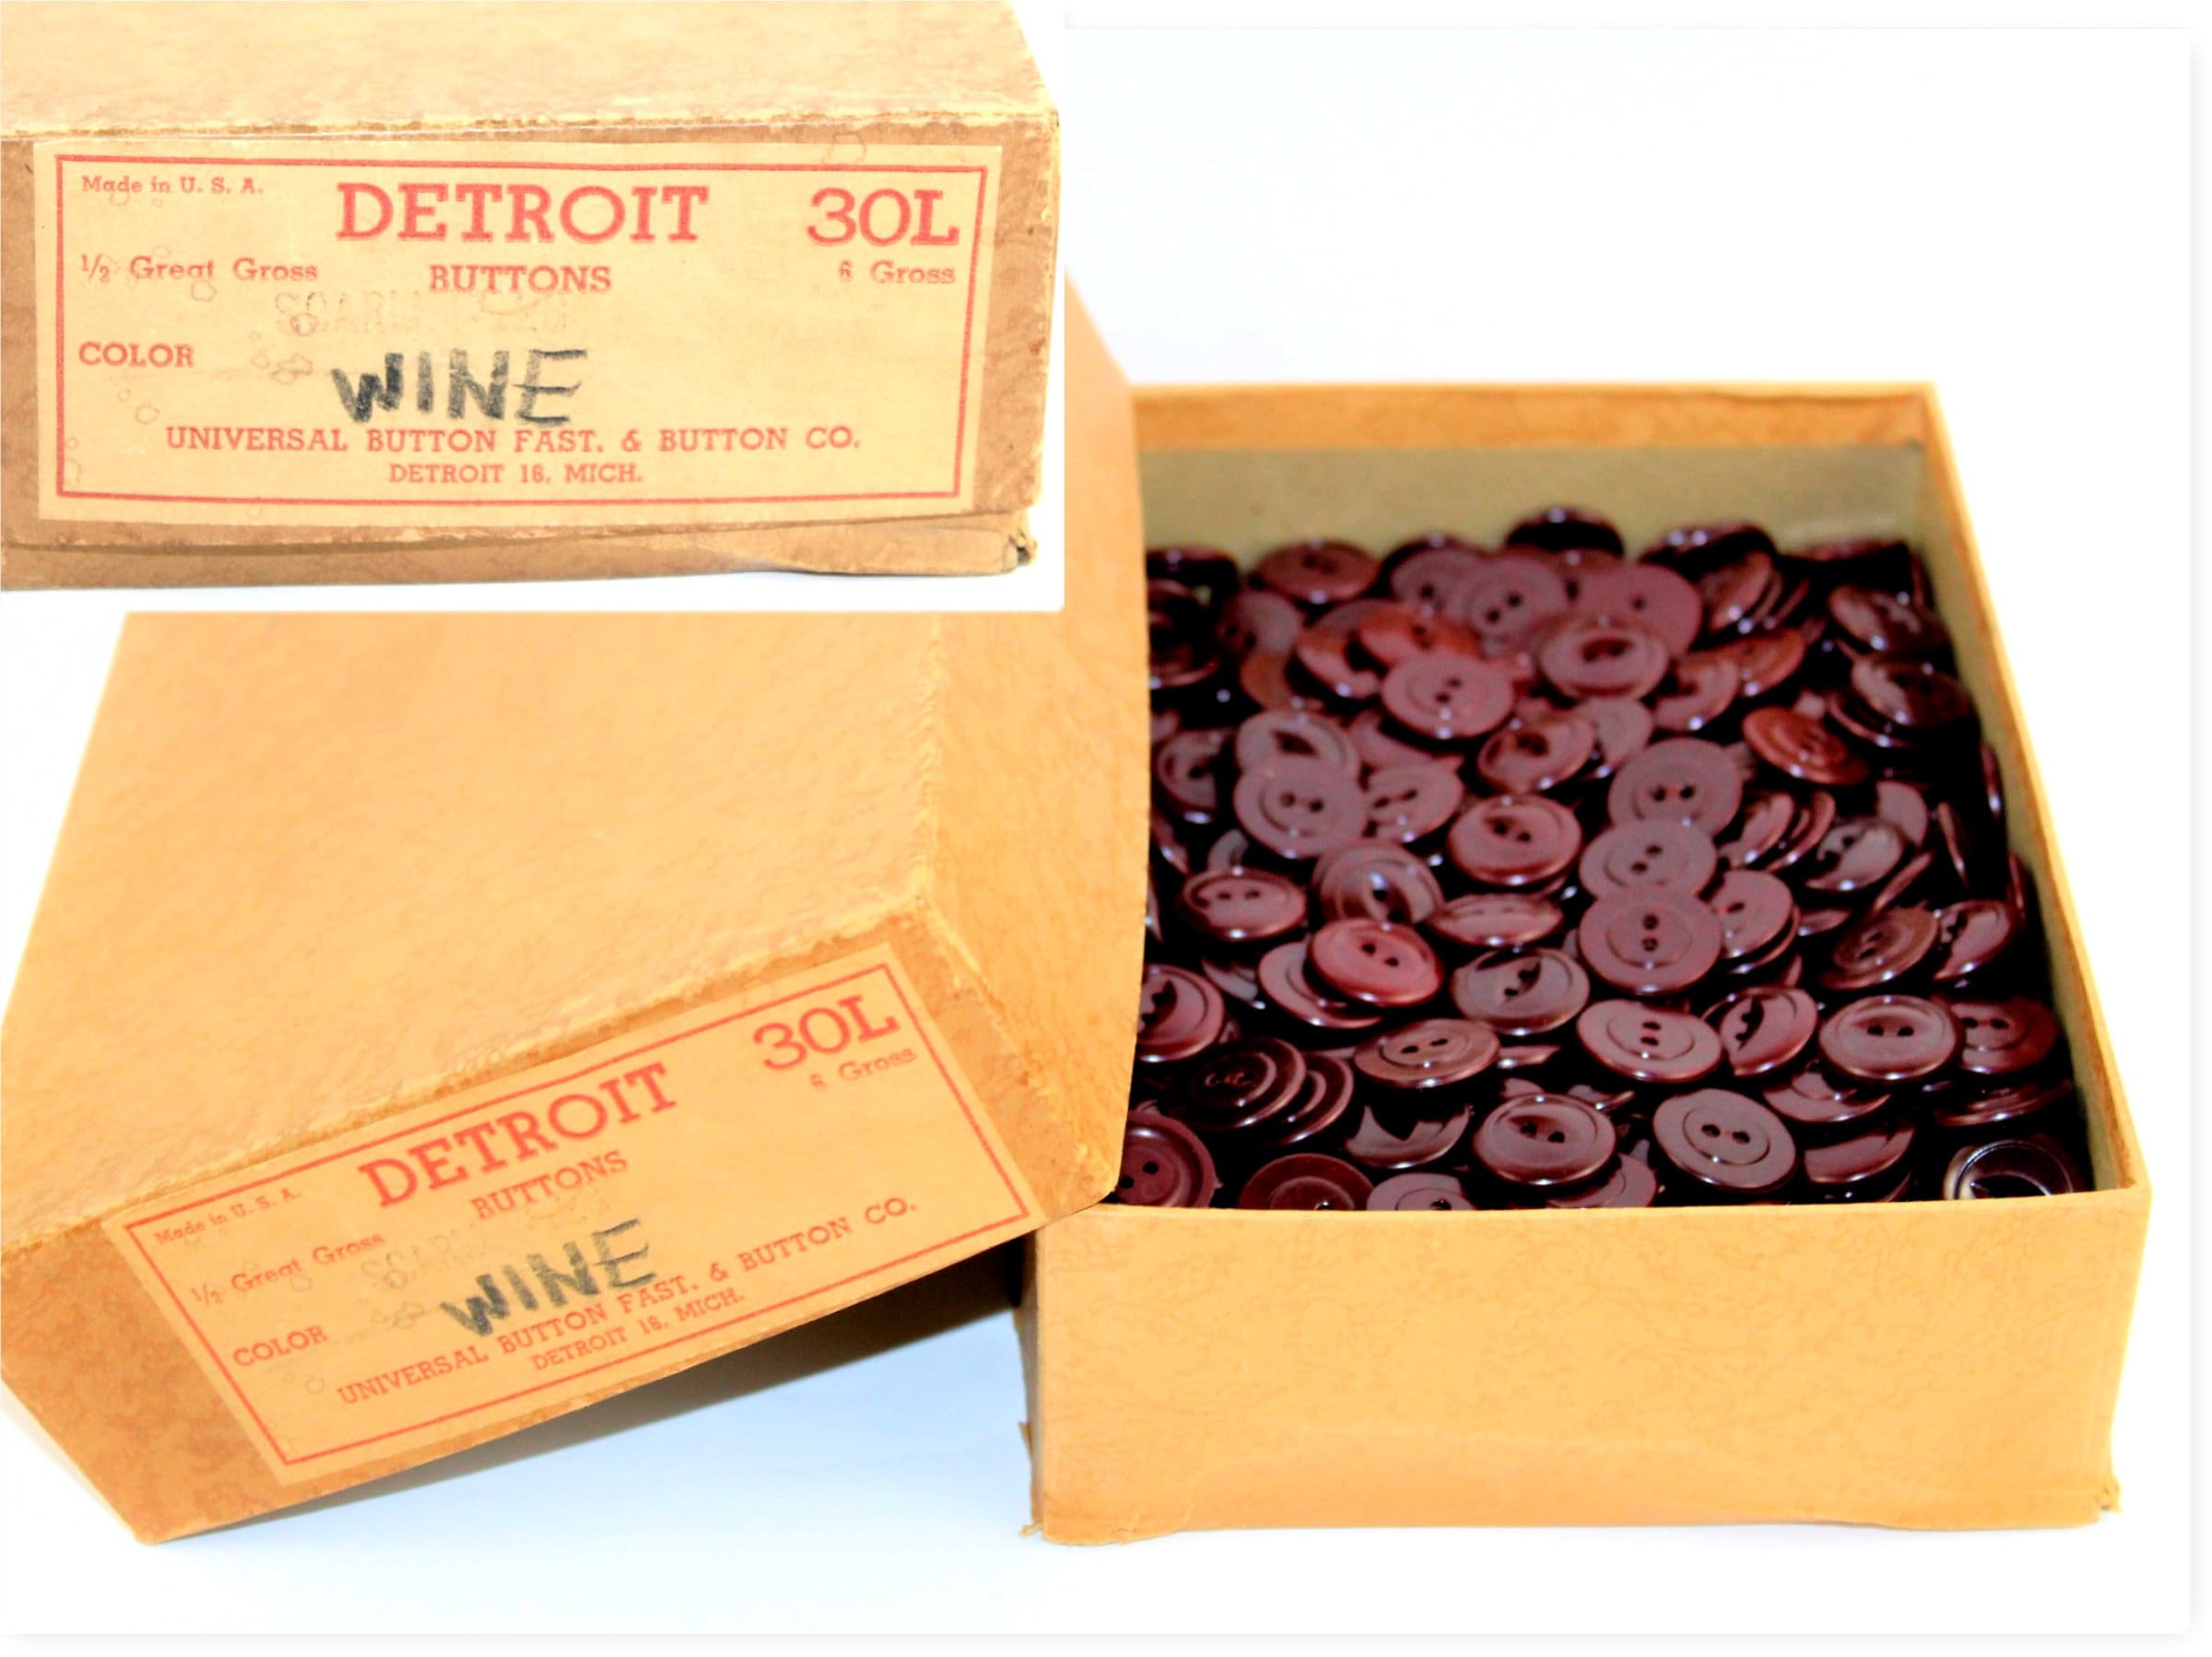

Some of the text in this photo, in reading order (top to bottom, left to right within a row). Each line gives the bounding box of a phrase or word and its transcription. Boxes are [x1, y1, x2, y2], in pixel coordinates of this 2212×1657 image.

[81, 175, 264, 194] Made in U. S. A.
[336, 182, 709, 244] DETROIT
[806, 187, 959, 247] 30L
[129, 256, 214, 280] Great
[233, 257, 318, 282] Gross
[429, 264, 612, 294] BUTTONS
[839, 261, 957, 284] 6 Gross
[79, 342, 194, 368] COLOR
[332, 348, 587, 425] WINE
[166, 426, 861, 452] UNIVERSAL BUTTON FAST. & BUTTON CO.
[389, 464, 505, 484] DETROIT
[565, 464, 642, 484] MICH.
[751, 994, 900, 1071] 30L
[838, 1048, 917, 1081] Gross
[358, 1063, 677, 1207] DETROIT
[471, 1149, 628, 1220] BUTTONS
[154, 1219, 206, 1245] Made
[209, 1211, 230, 1230] in
[230, 1259, 302, 1292] Great
[312, 1233, 385, 1266] Gross
[441, 1217, 657, 1337] WINE
[337, 1197, 917, 1405] UNIVERSAL BUTTON FAST. & BUTTON CO.
[231, 1325, 328, 1368] COLOR
[530, 1327, 629, 1371] DETROIT
[677, 1287, 746, 1323] MICH.
